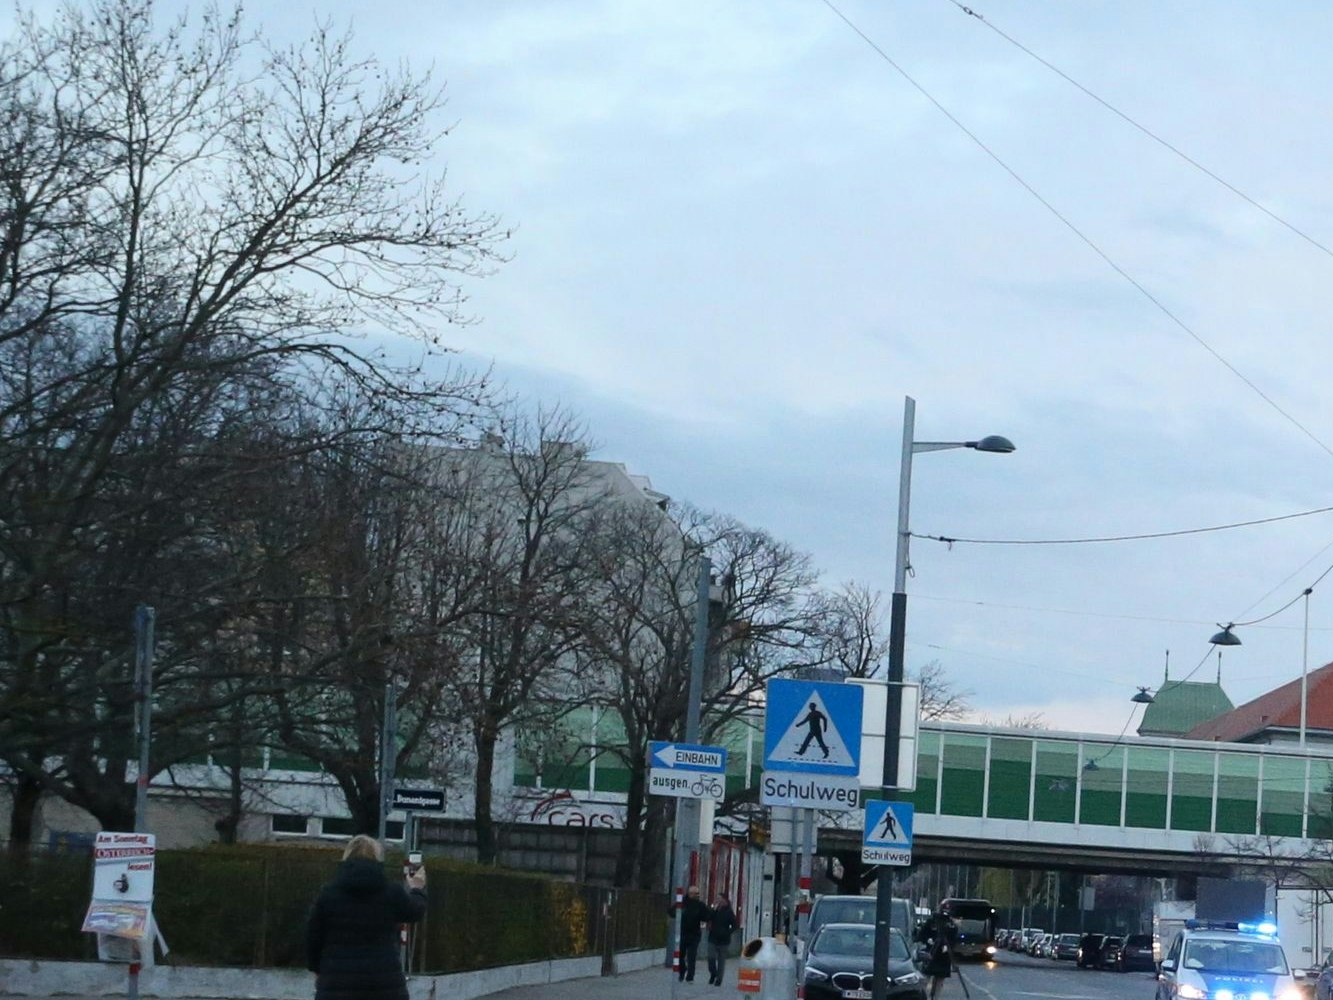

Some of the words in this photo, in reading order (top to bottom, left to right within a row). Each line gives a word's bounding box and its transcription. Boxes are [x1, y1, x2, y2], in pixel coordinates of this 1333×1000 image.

[675, 751, 719, 766] EINBAHN
[652, 776, 690, 790] ausgen.
[764, 777, 858, 807] Schulweg
[549, 811, 614, 829] cars
[98, 835, 112, 843] Am
[114, 835, 149, 845] Sonntag
[863, 850, 911, 863] Schulweg
[127, 861, 152, 871] lesen!
